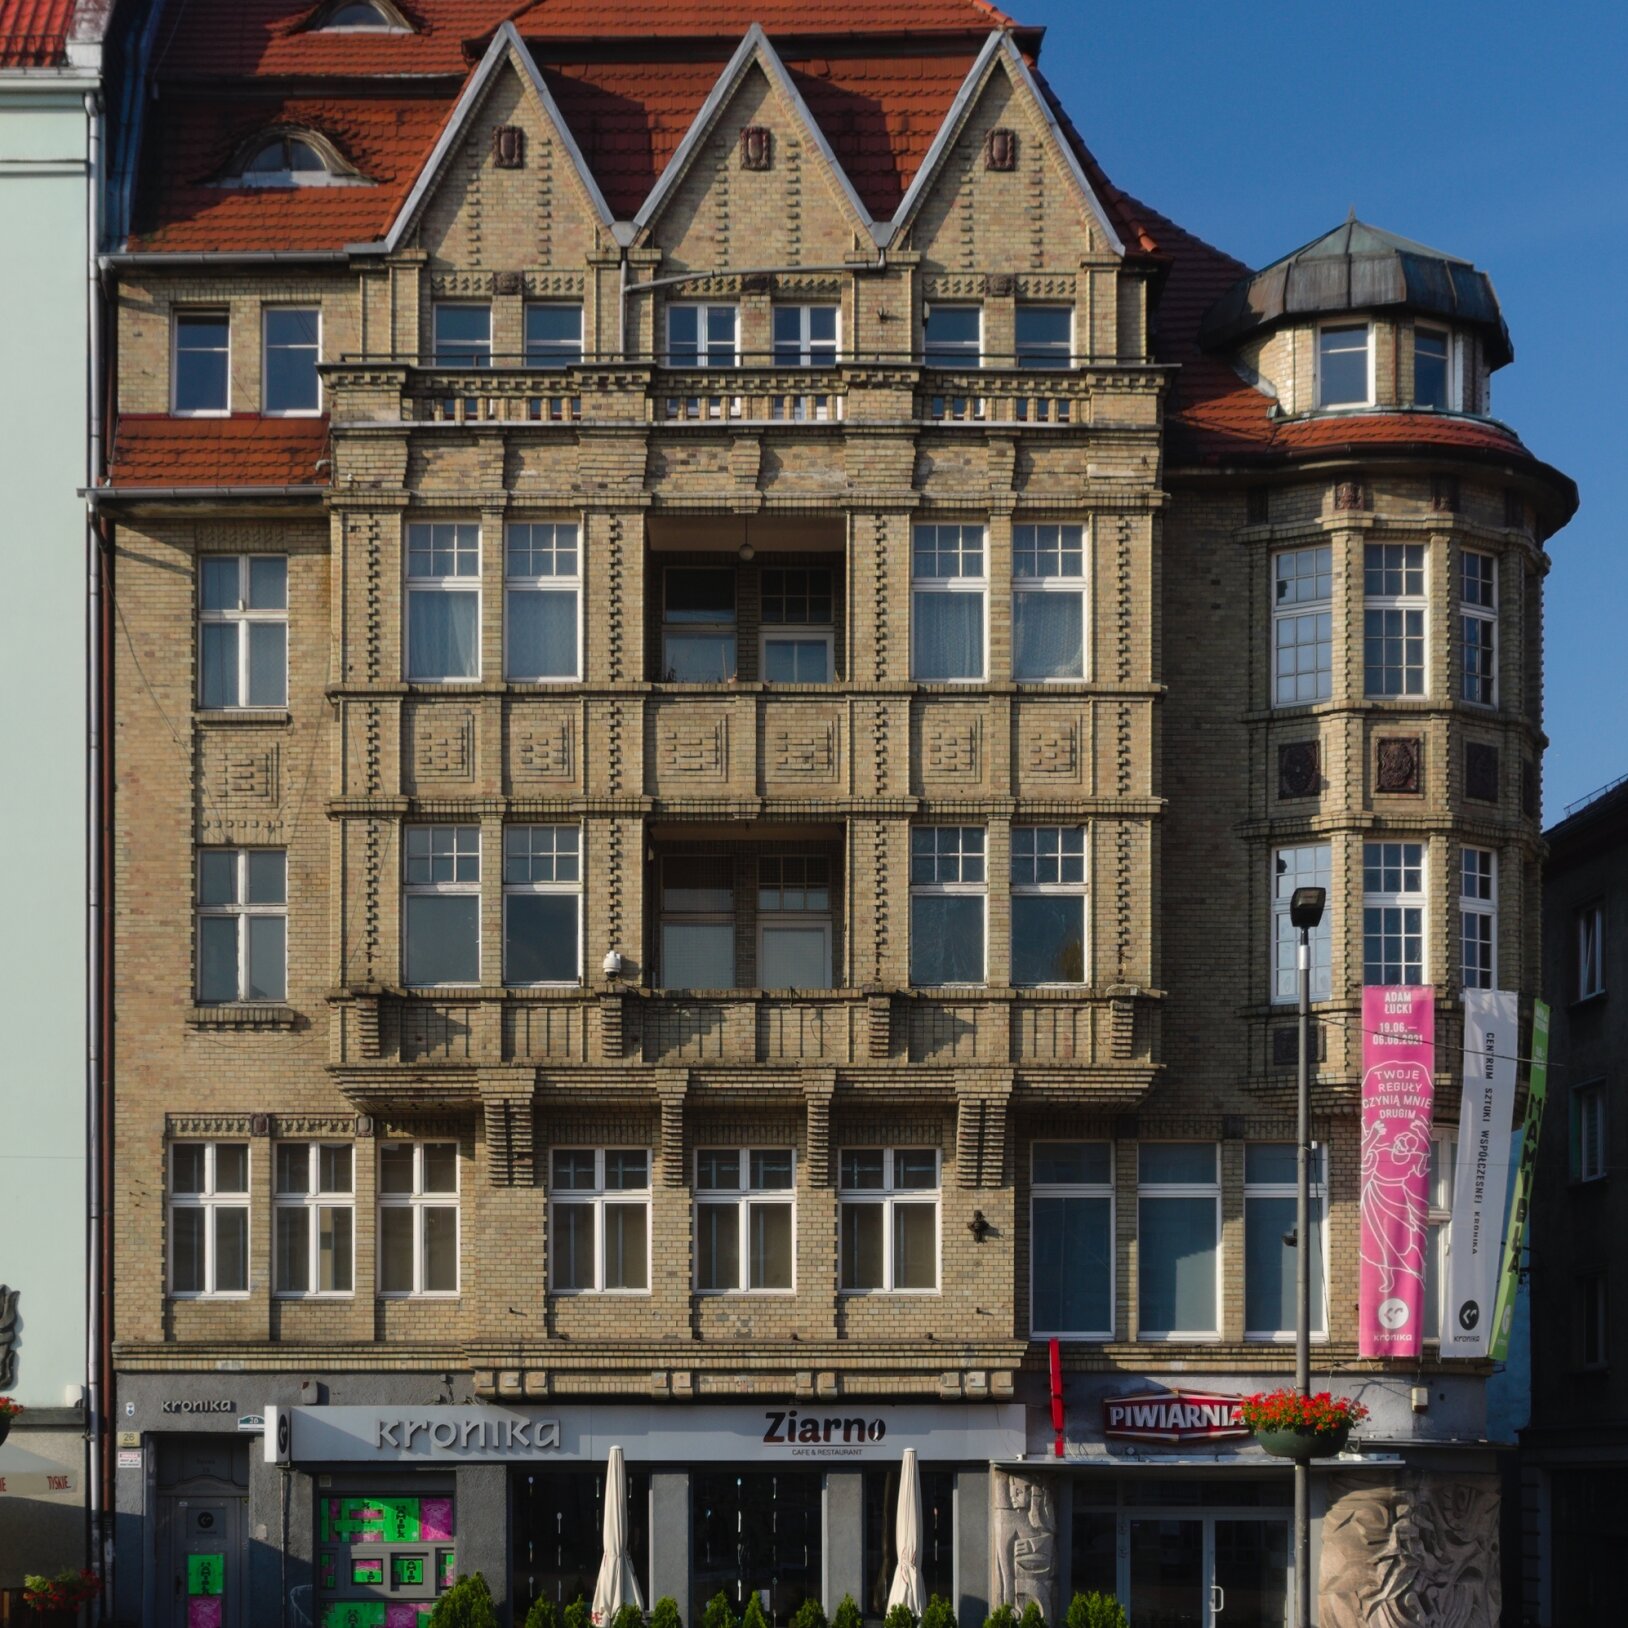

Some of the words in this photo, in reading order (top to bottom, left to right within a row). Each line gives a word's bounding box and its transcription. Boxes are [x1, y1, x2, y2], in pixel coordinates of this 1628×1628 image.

[1384, 991, 1412, 1003] ADAM
[1384, 1003, 1412, 1014] ŁUCKI
[1374, 1069, 1420, 1080] TWOJE
[1378, 1083, 1422, 1093] REGUŁY
[1362, 1095, 1401, 1109] CZYNIĄ
[1403, 1096, 1432, 1109] MNIE
[1482, 1088, 1493, 1122] SZTUKI
[1380, 1109, 1416, 1119] DRUGIM
[1472, 1211, 1481, 1255] KRONIKA
[1373, 1333, 1412, 1342] kronika
[161, 1400, 232, 1413] kronika
[763, 1410, 886, 1443] Ziarno
[123, 1432, 135, 1442] 26
[375, 1418, 560, 1449] kronika
